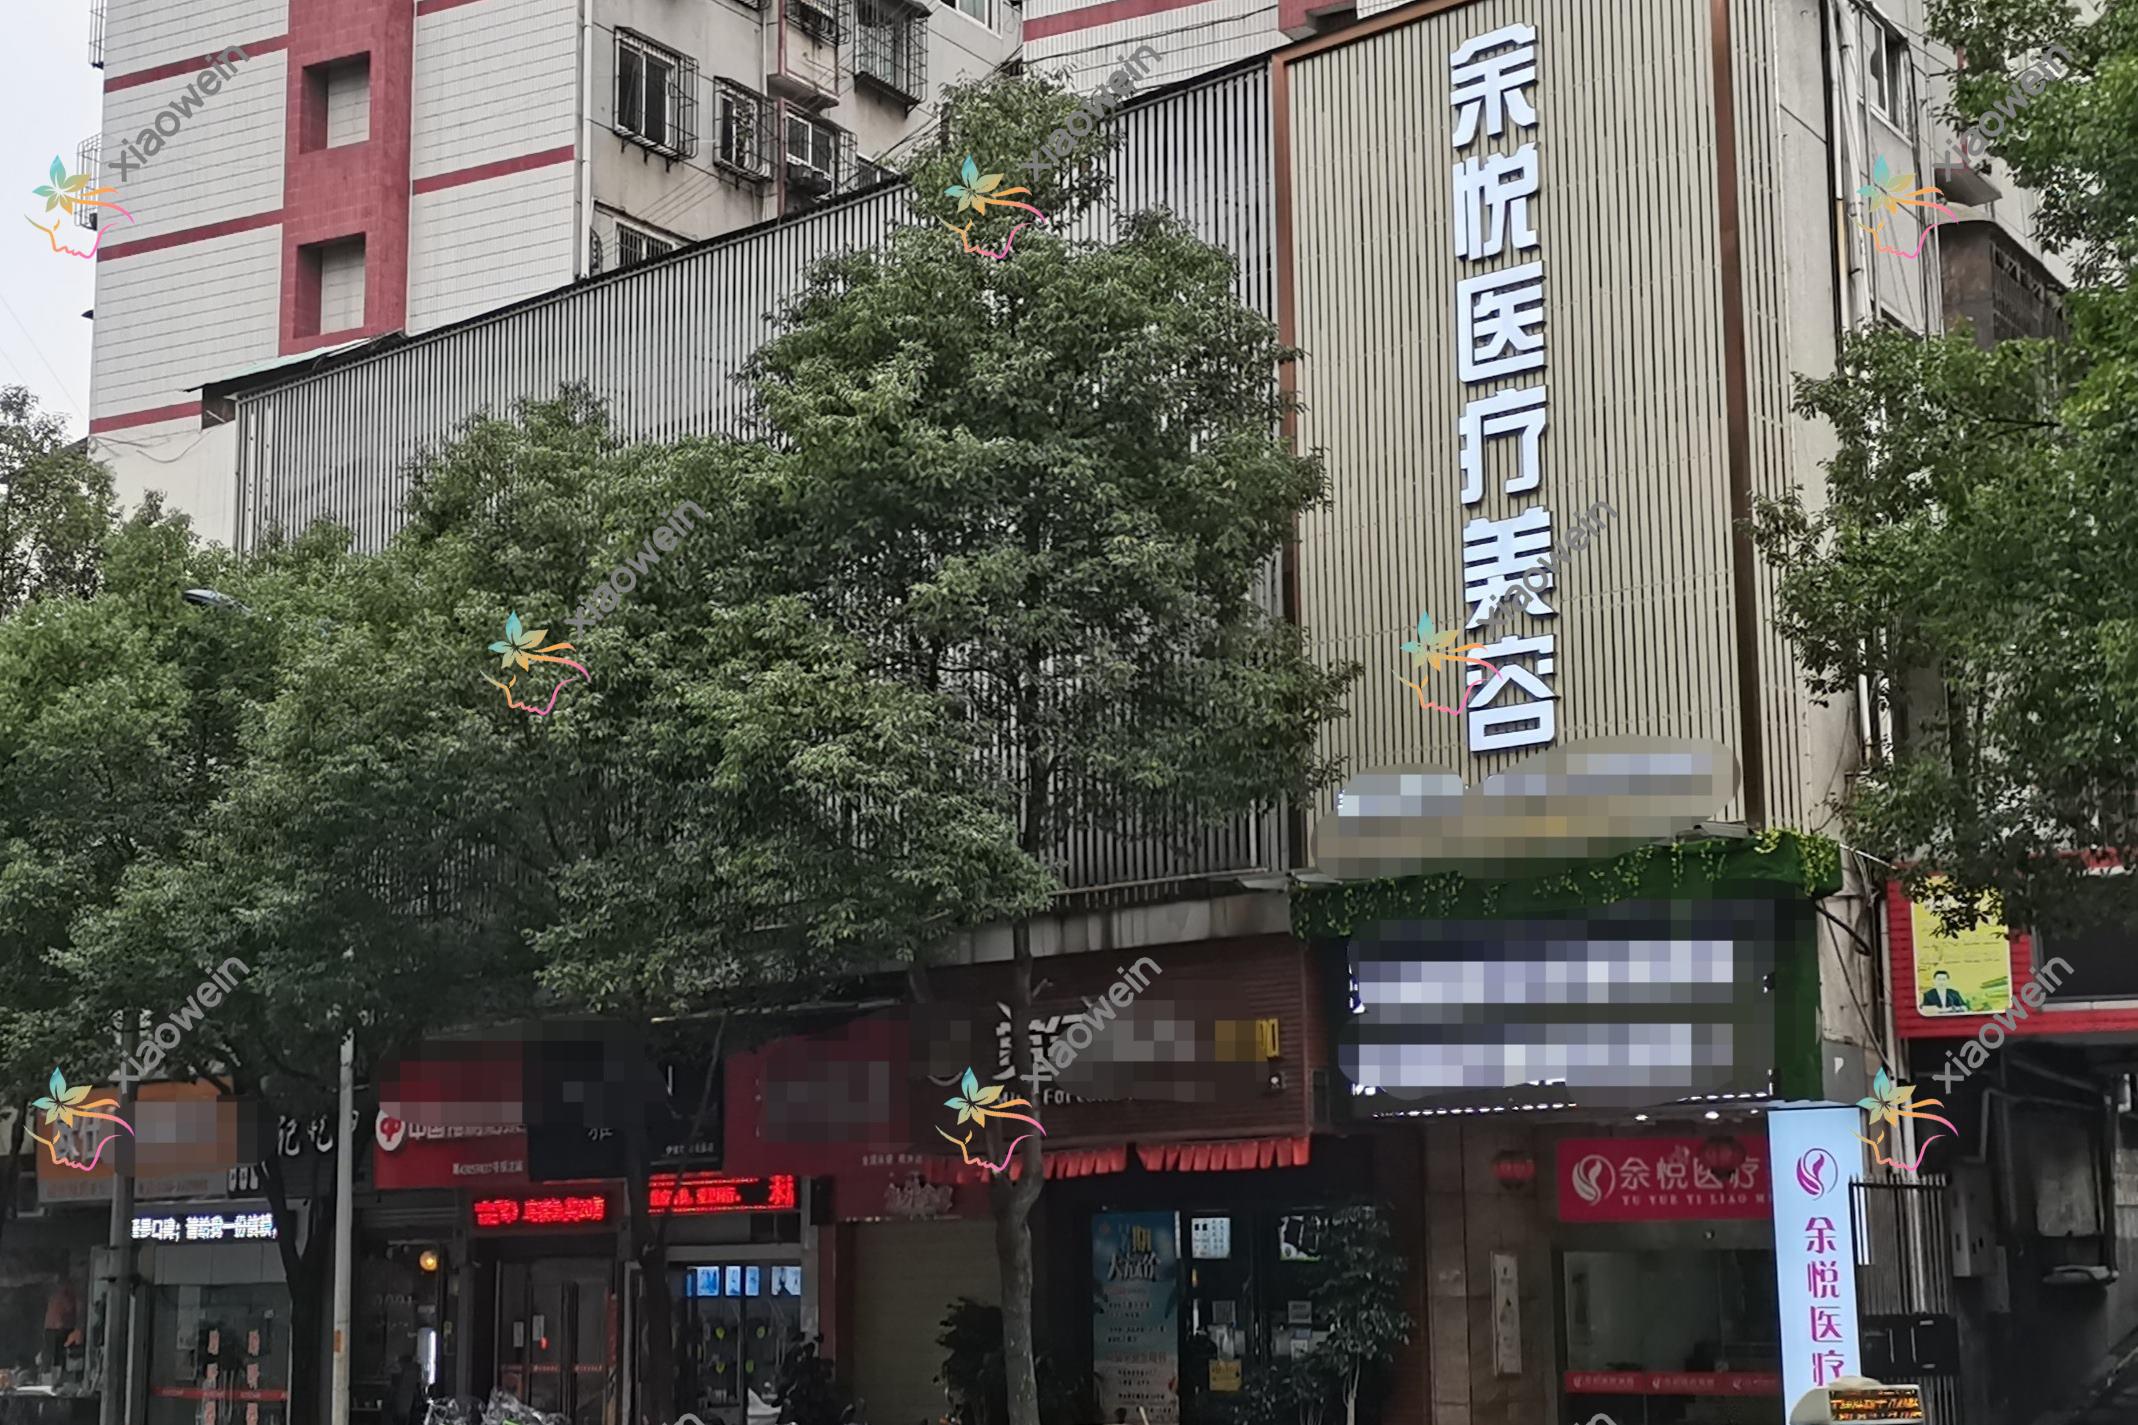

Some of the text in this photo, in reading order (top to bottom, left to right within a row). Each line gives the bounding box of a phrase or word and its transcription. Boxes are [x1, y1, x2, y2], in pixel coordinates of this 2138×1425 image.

[1449, 22, 1559, 753] 余悦医疗美容
[1621, 1194, 1640, 1206] YU
[1649, 1194, 1676, 1206] YUE
[1710, 1191, 1748, 1205] LIAO
[1804, 1215, 1845, 1387] 余悦医疗
